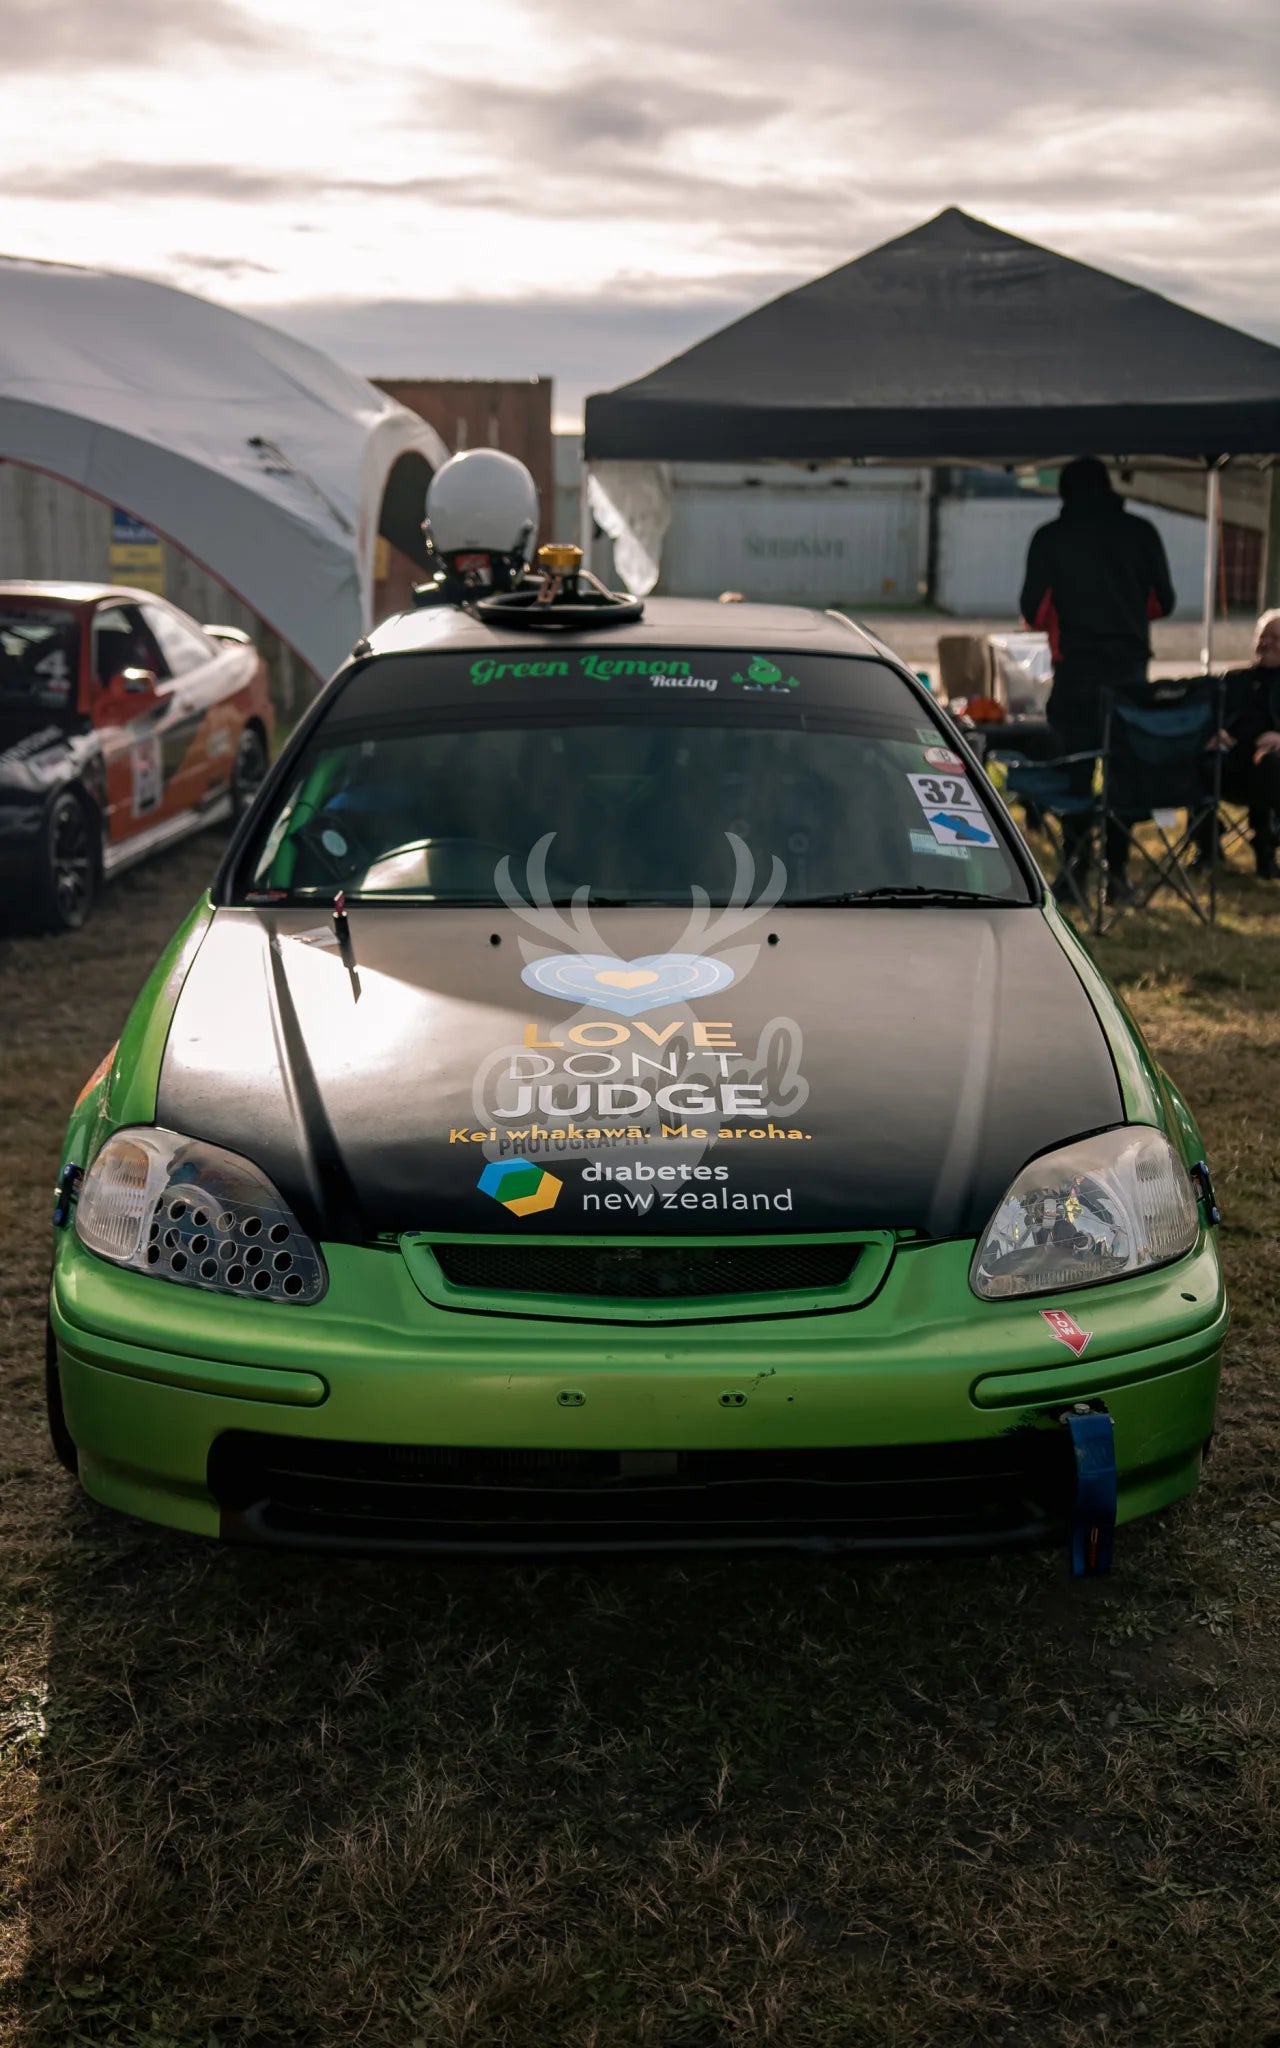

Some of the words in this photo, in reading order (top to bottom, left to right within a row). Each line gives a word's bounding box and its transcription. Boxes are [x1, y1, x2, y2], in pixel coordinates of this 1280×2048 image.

[470, 659, 569, 685] Green
[580, 655, 690, 681] Lemon
[650, 674, 718, 692] Racing
[918, 778, 971, 804] 32
[524, 1021, 737, 1048] LOVE
[509, 1052, 744, 1080] DON'T
[491, 1084, 768, 1118] JUDGE
[449, 1127, 497, 1144] Kei
[662, 1123, 708, 1139] Me
[717, 1123, 812, 1140] aroha.
[581, 1162, 729, 1182] diabetes
[583, 1193, 655, 1211] new
[663, 1188, 793, 1211] zealand
[1050, 1313, 1075, 1335] TOW
